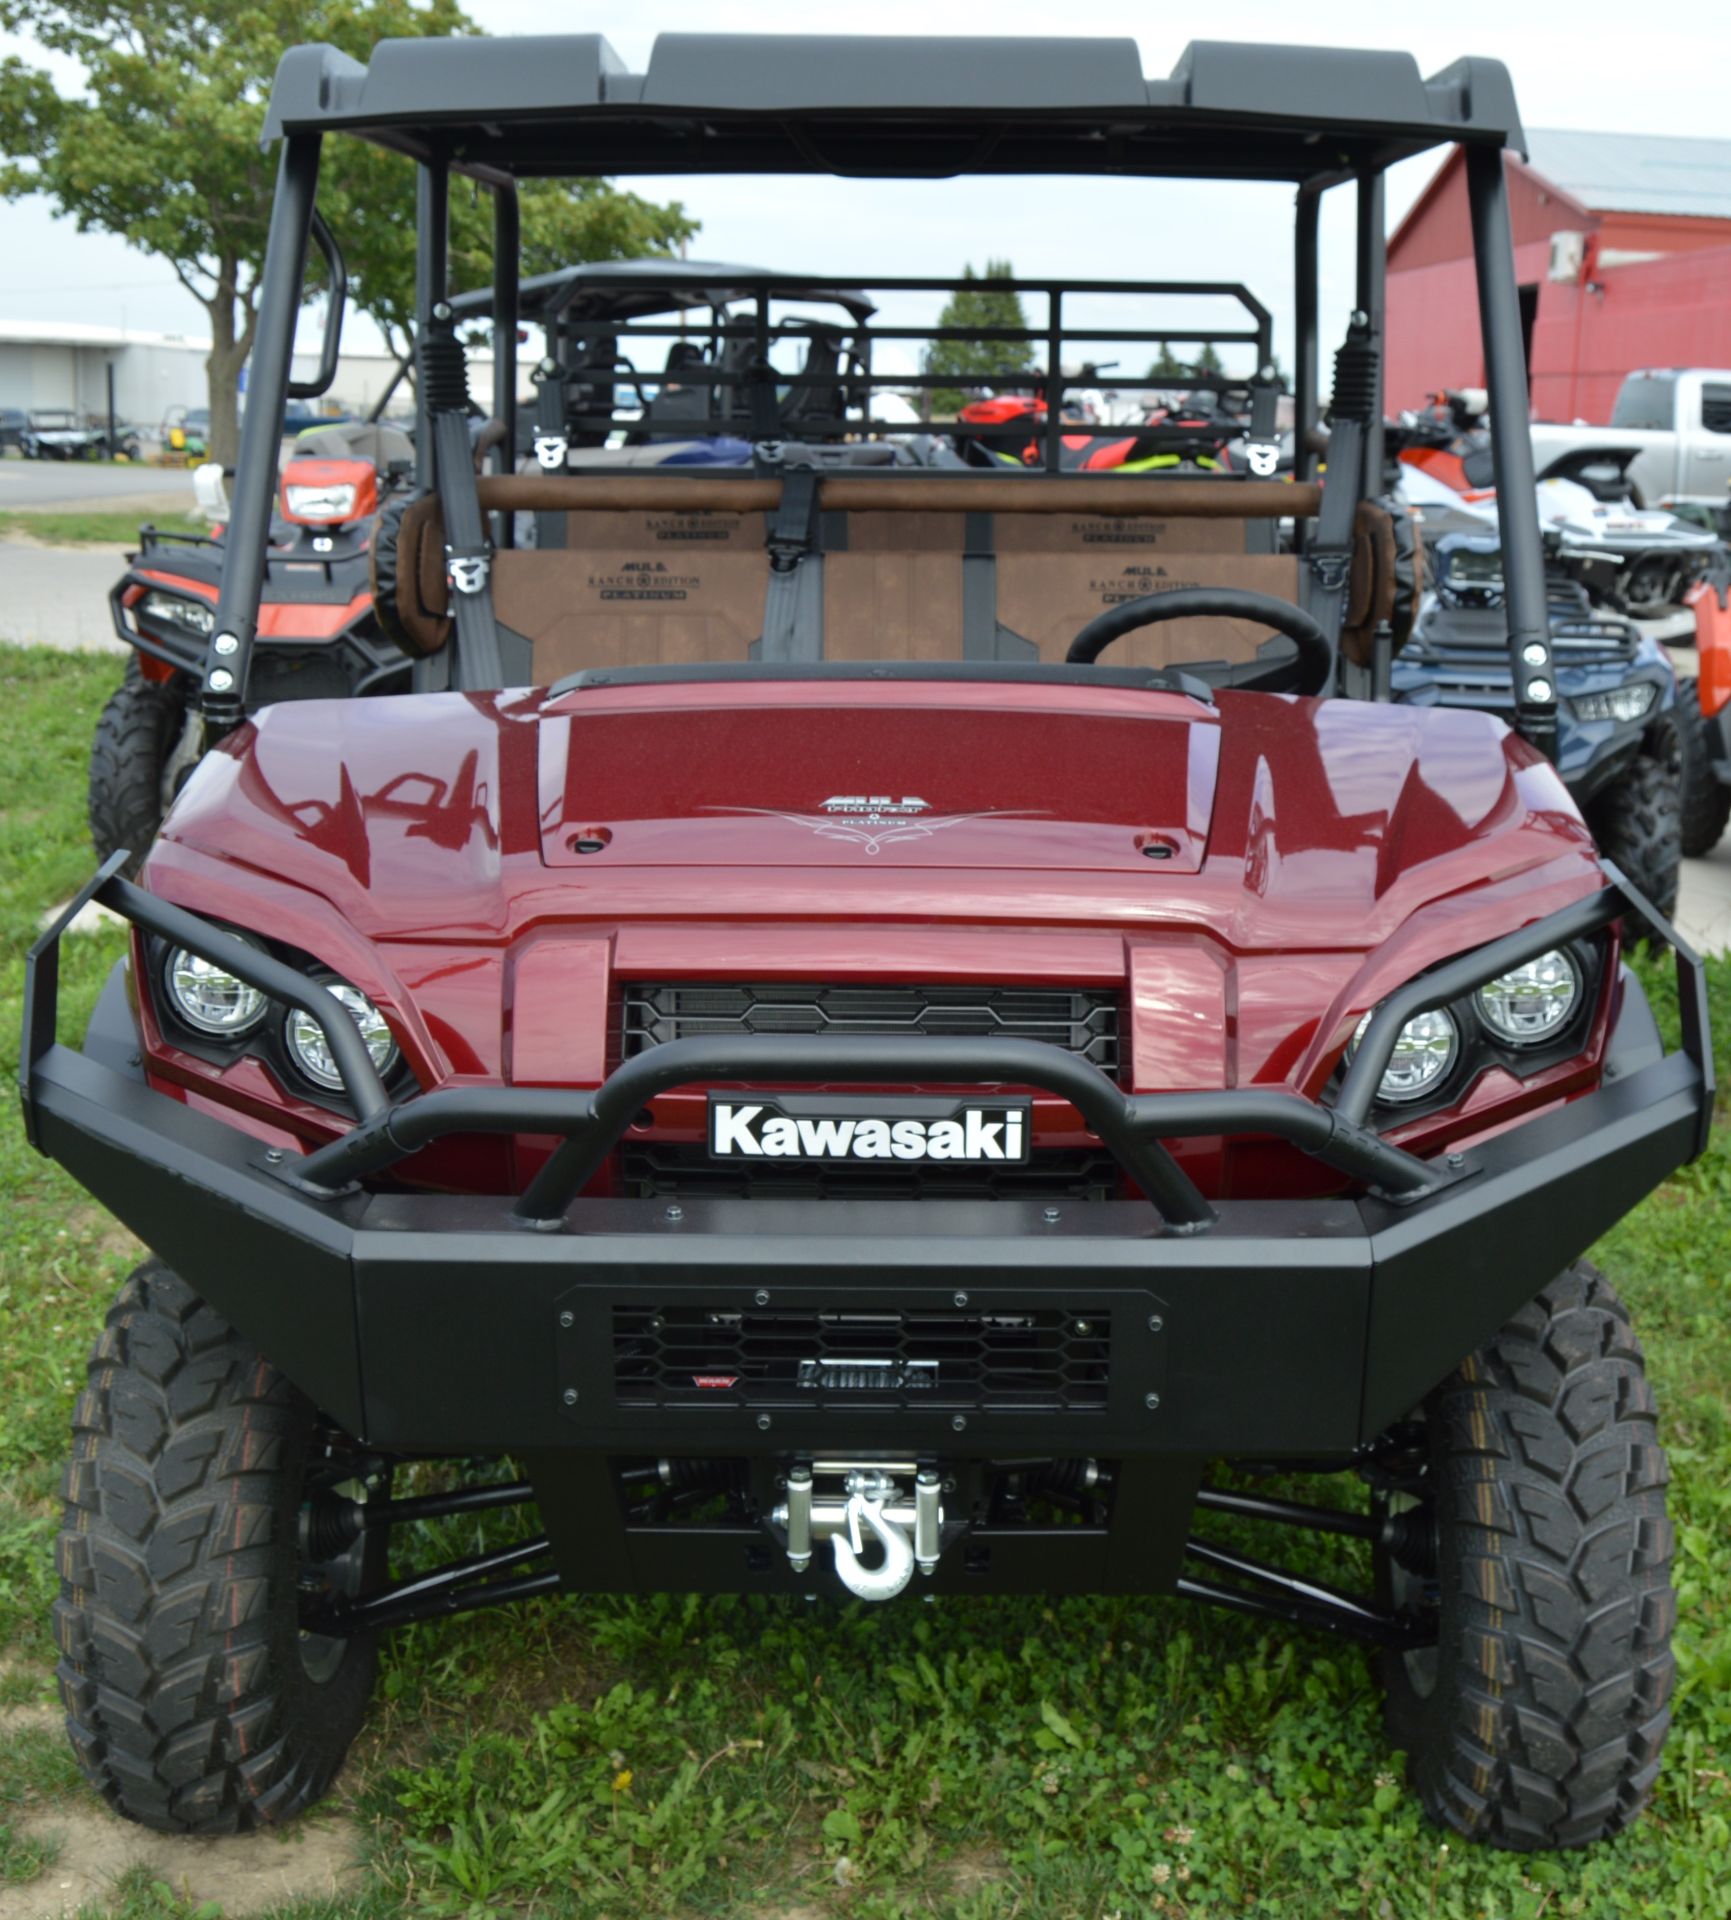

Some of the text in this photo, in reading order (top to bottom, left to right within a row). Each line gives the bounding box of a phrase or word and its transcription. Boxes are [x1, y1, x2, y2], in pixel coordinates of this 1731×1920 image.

[621, 562, 668, 572] MULE
[588, 575, 700, 586] RANCH EDITION
[1089, 580, 1135, 591] RANCH
[602, 590, 687, 600] PLATINUM
[714, 1104, 1025, 1159] Kawasaki
